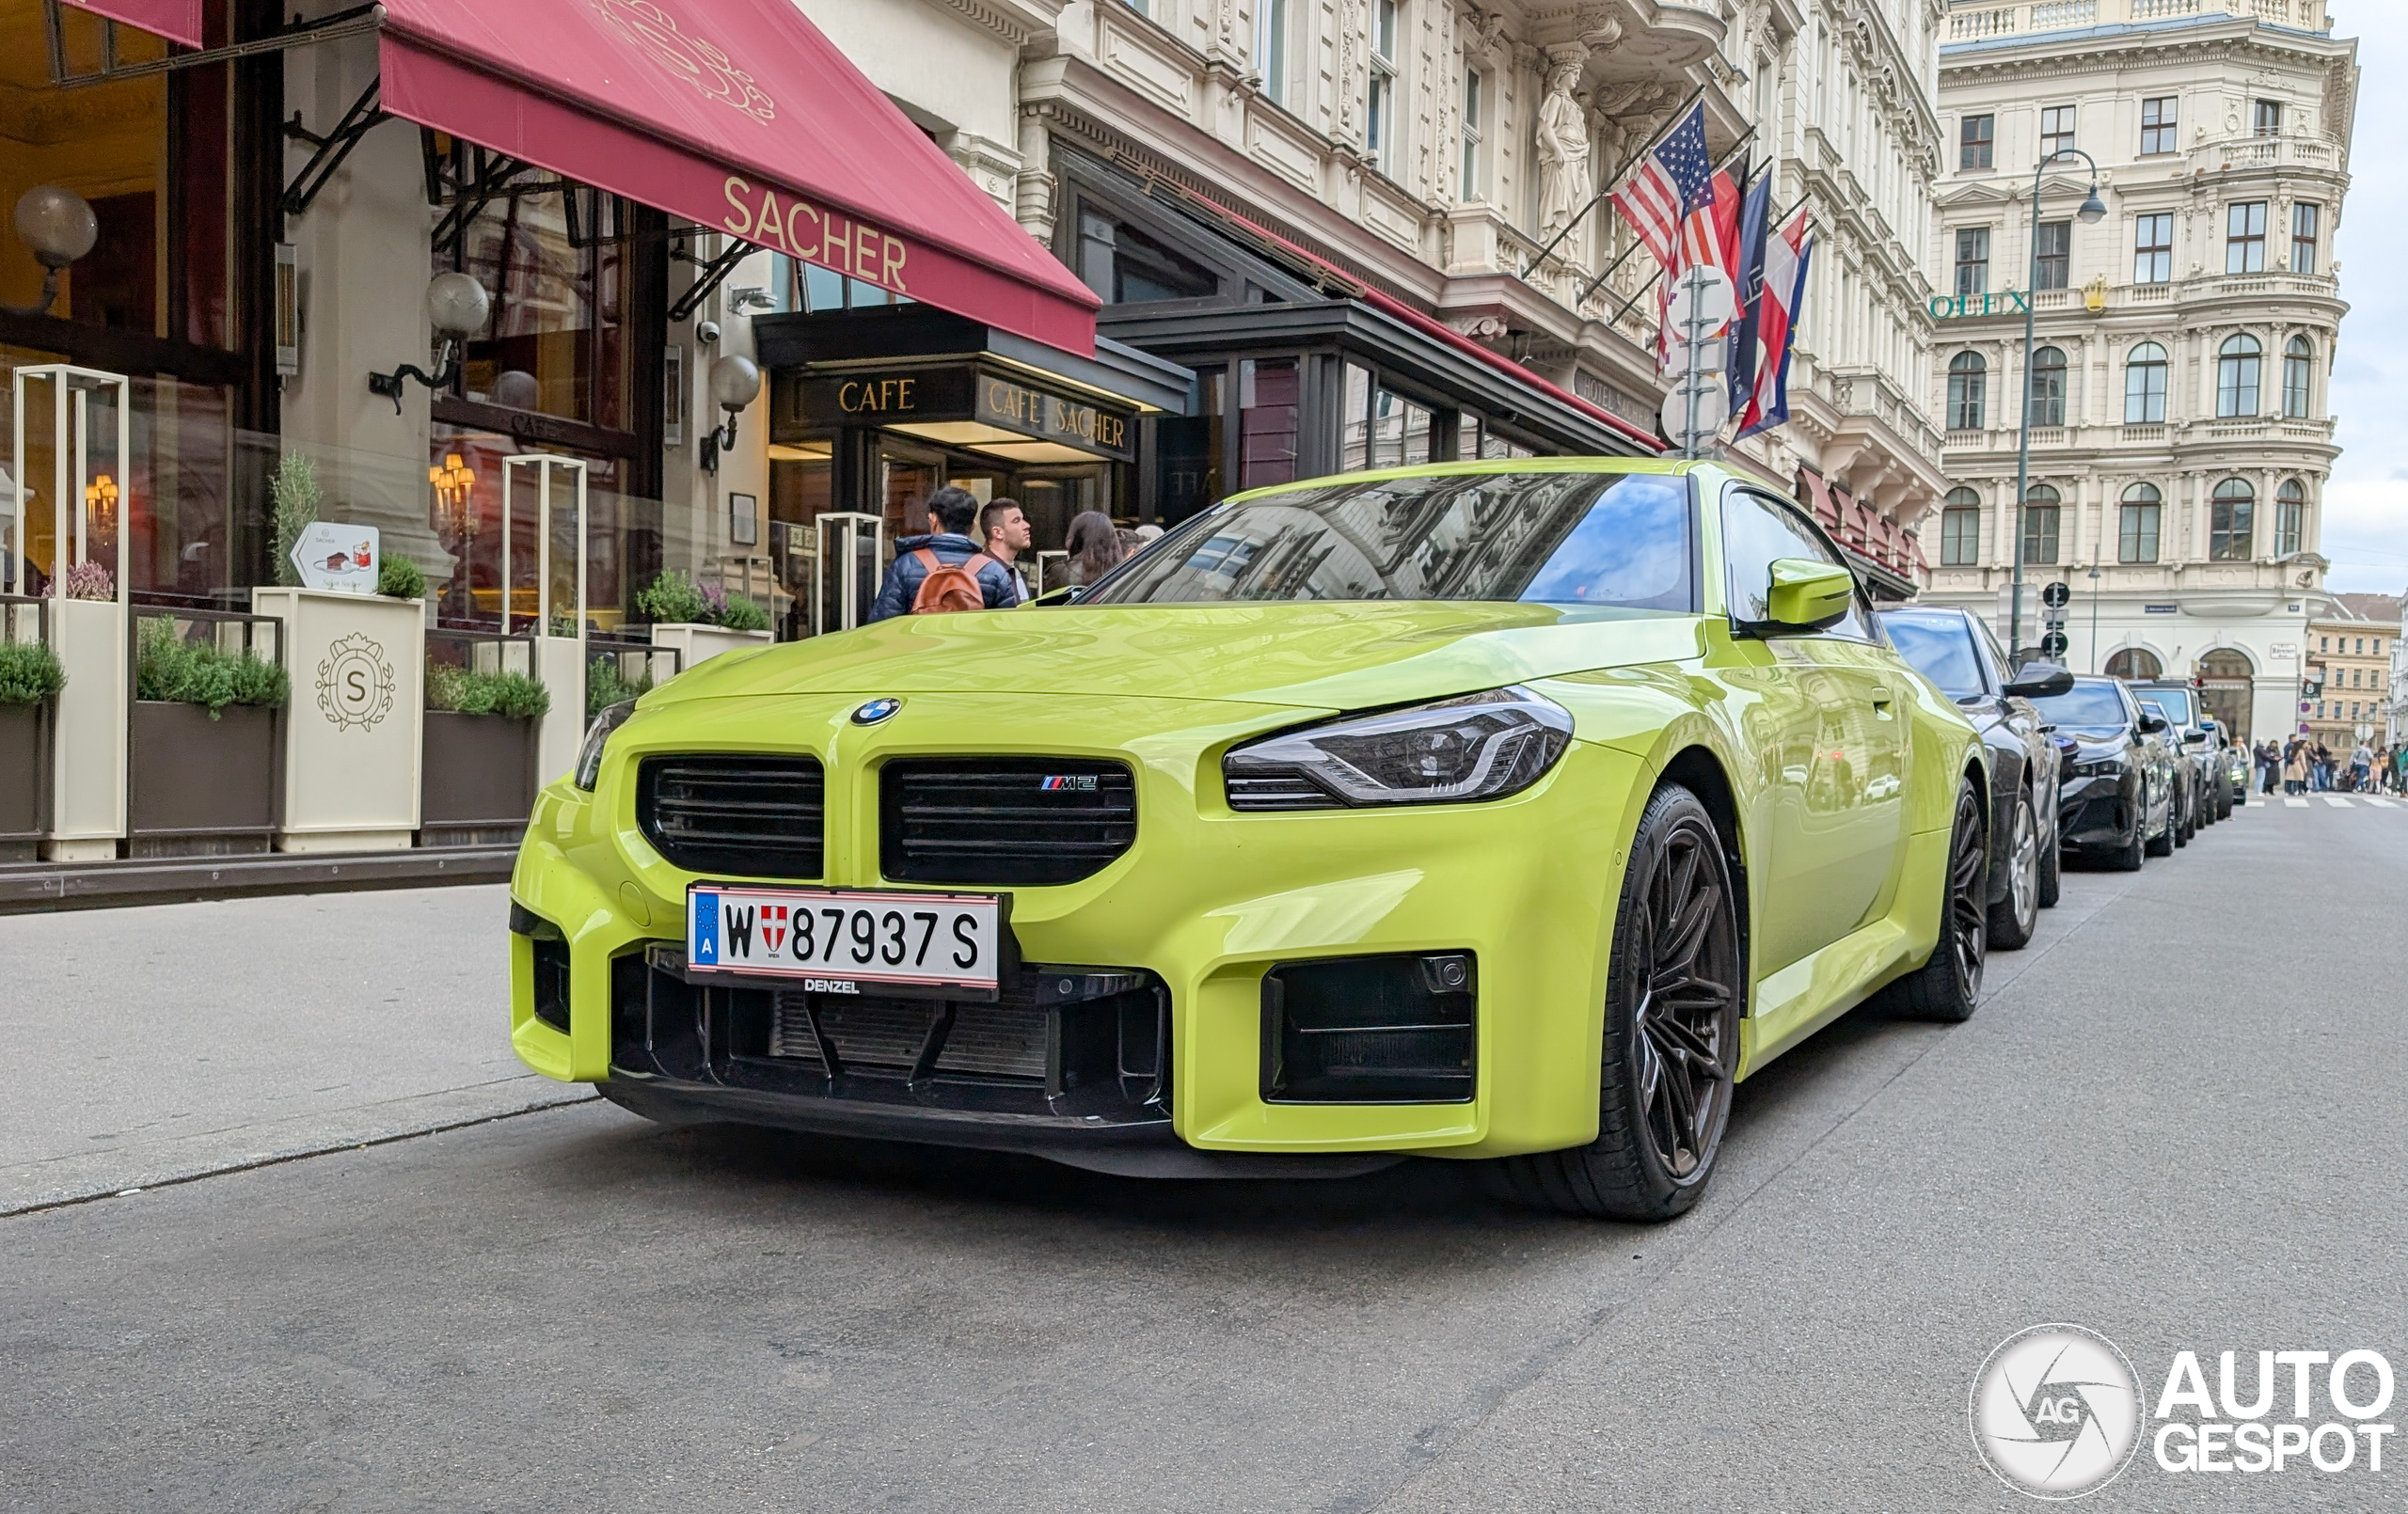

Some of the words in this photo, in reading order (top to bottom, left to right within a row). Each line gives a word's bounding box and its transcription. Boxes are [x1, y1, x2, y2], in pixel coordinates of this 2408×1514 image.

[723, 170, 907, 292] SACHER
[1930, 291, 2030, 319] OLEX
[839, 379, 915, 412] CAFE
[1583, 376, 1613, 411] HOTEL
[1616, 393, 1651, 431] SACHER
[990, 382, 1041, 424] CAFE
[1055, 402, 1125, 448] SACHER
[346, 670, 366, 702] S
[1061, 776, 1098, 791] M2
[701, 938, 713, 954] A
[725, 904, 754, 958] W
[792, 907, 939, 967] 87937
[953, 913, 978, 970] S
[804, 978, 861, 995] DENZEL
